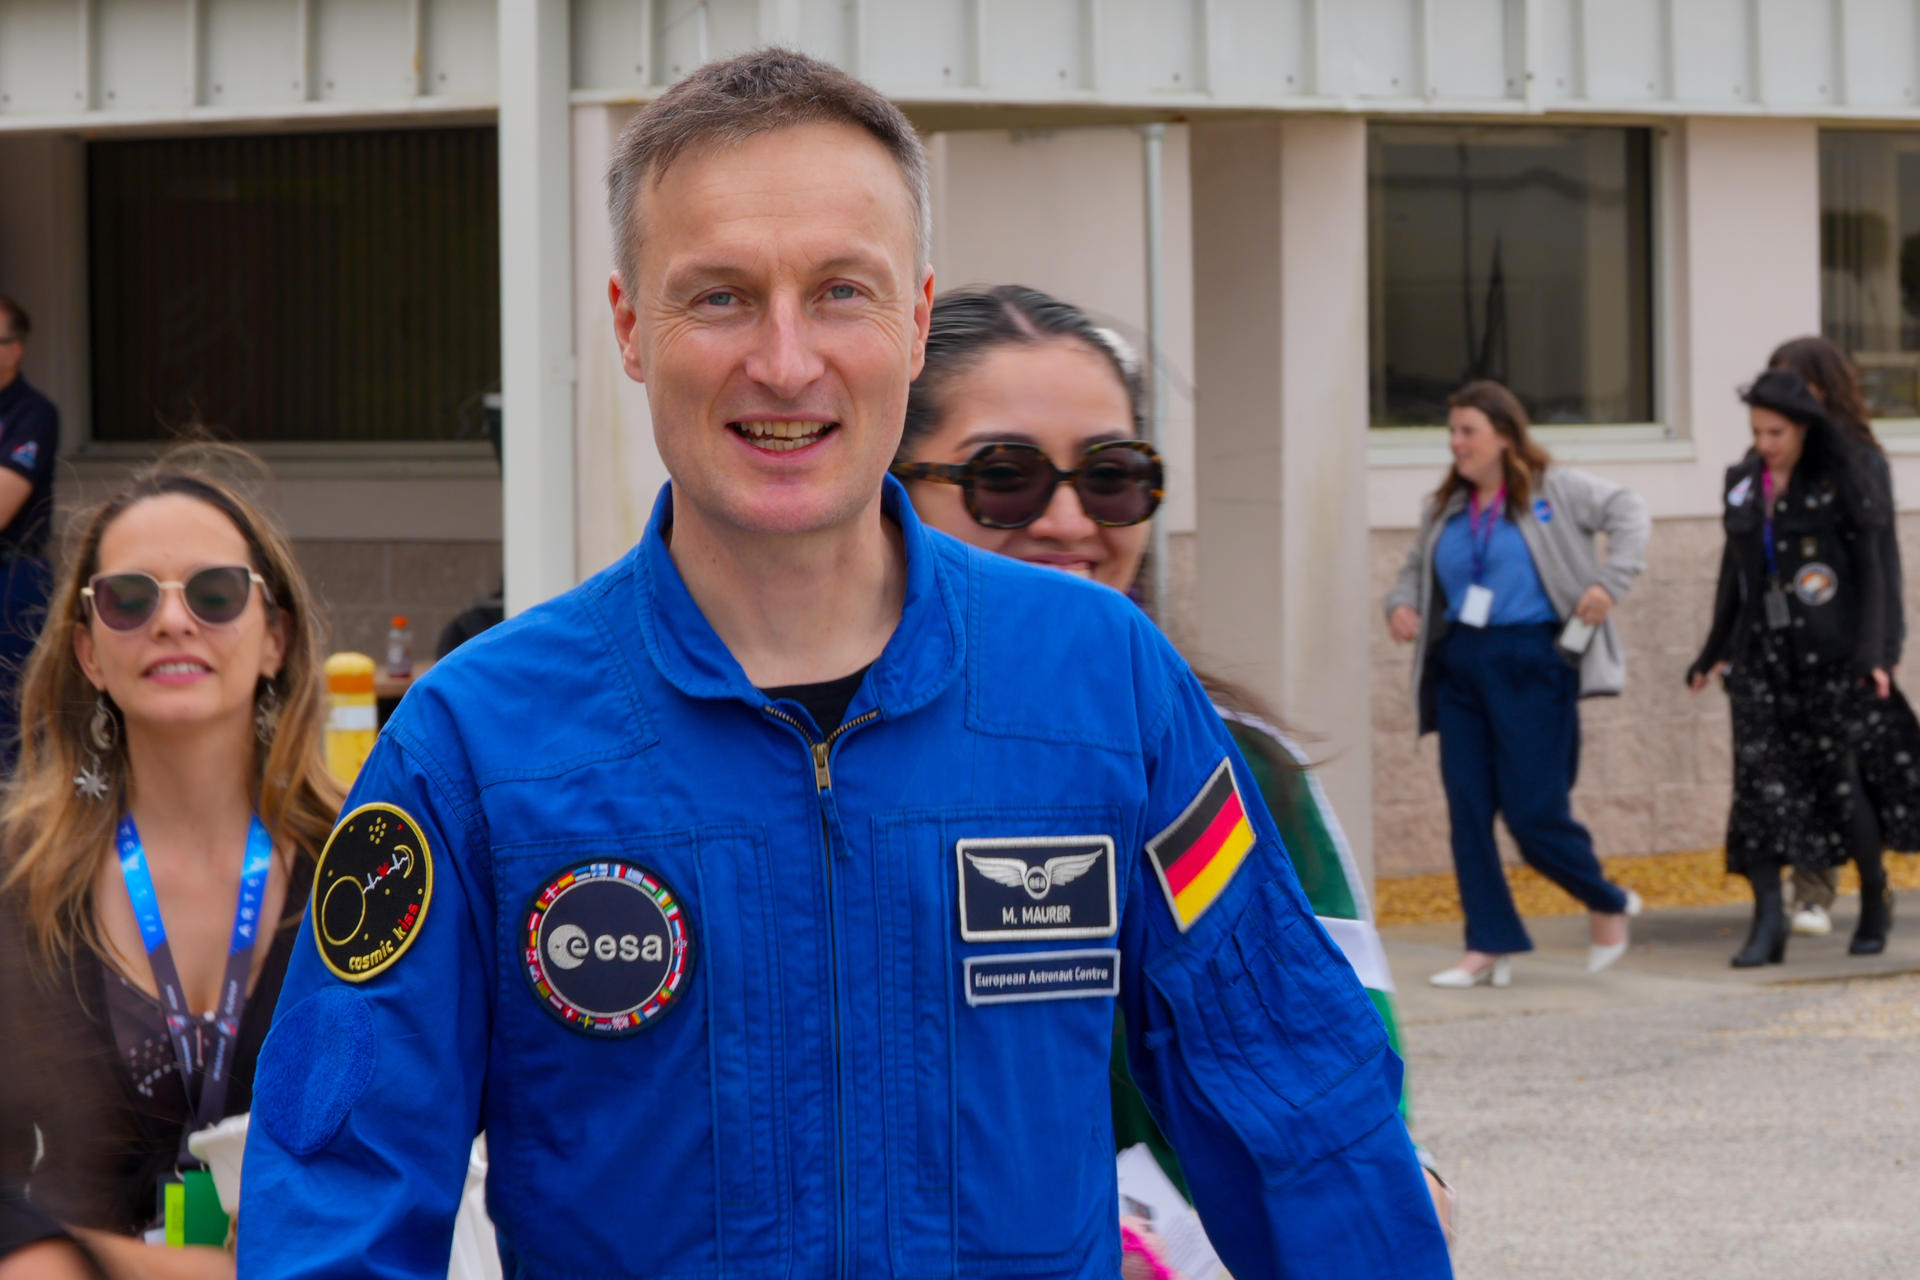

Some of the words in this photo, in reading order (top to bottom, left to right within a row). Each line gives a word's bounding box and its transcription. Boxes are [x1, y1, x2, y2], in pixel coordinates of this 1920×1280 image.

[1002, 906, 1018, 925] M.
[1022, 904, 1071, 924] MAURER
[348, 940, 395, 971] cosmic
[392, 903, 420, 941] kiss
[594, 934, 663, 963] esa
[975, 971, 1026, 989] European
[1028, 968, 1074, 984] Astronaut
[1074, 966, 1109, 982] Centre
